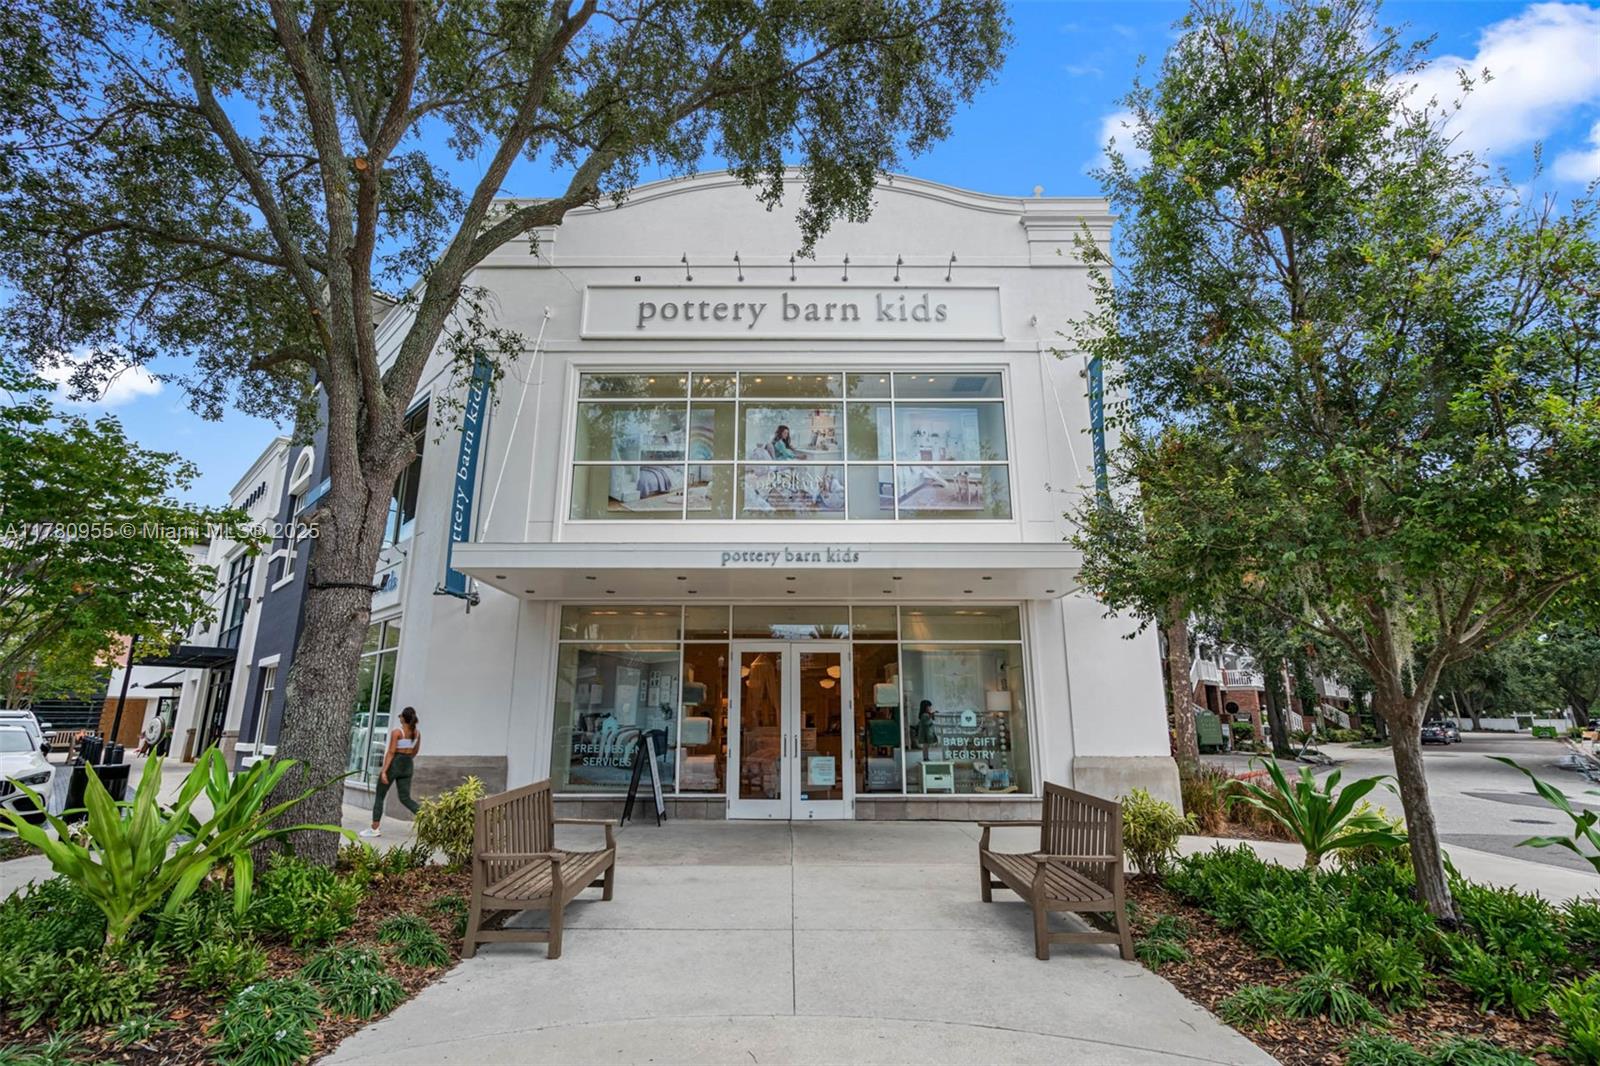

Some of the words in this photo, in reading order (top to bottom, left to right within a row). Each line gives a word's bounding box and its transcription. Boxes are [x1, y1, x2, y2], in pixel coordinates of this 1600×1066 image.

[635, 300, 768, 330] pottery
[781, 291, 861, 322] barn
[875, 292, 949, 322] kids
[457, 431, 474, 481] barn
[452, 486, 469, 541] ttery
[720, 551, 781, 567] pottery
[784, 546, 822, 562] barn
[826, 546, 860, 563] kids
[573, 743, 600, 754] FREE
[942, 736, 970, 747] BABY
[973, 736, 997, 747] GIFT
[582, 756, 632, 767] SERVICES
[944, 750, 996, 760] REGISTRY
